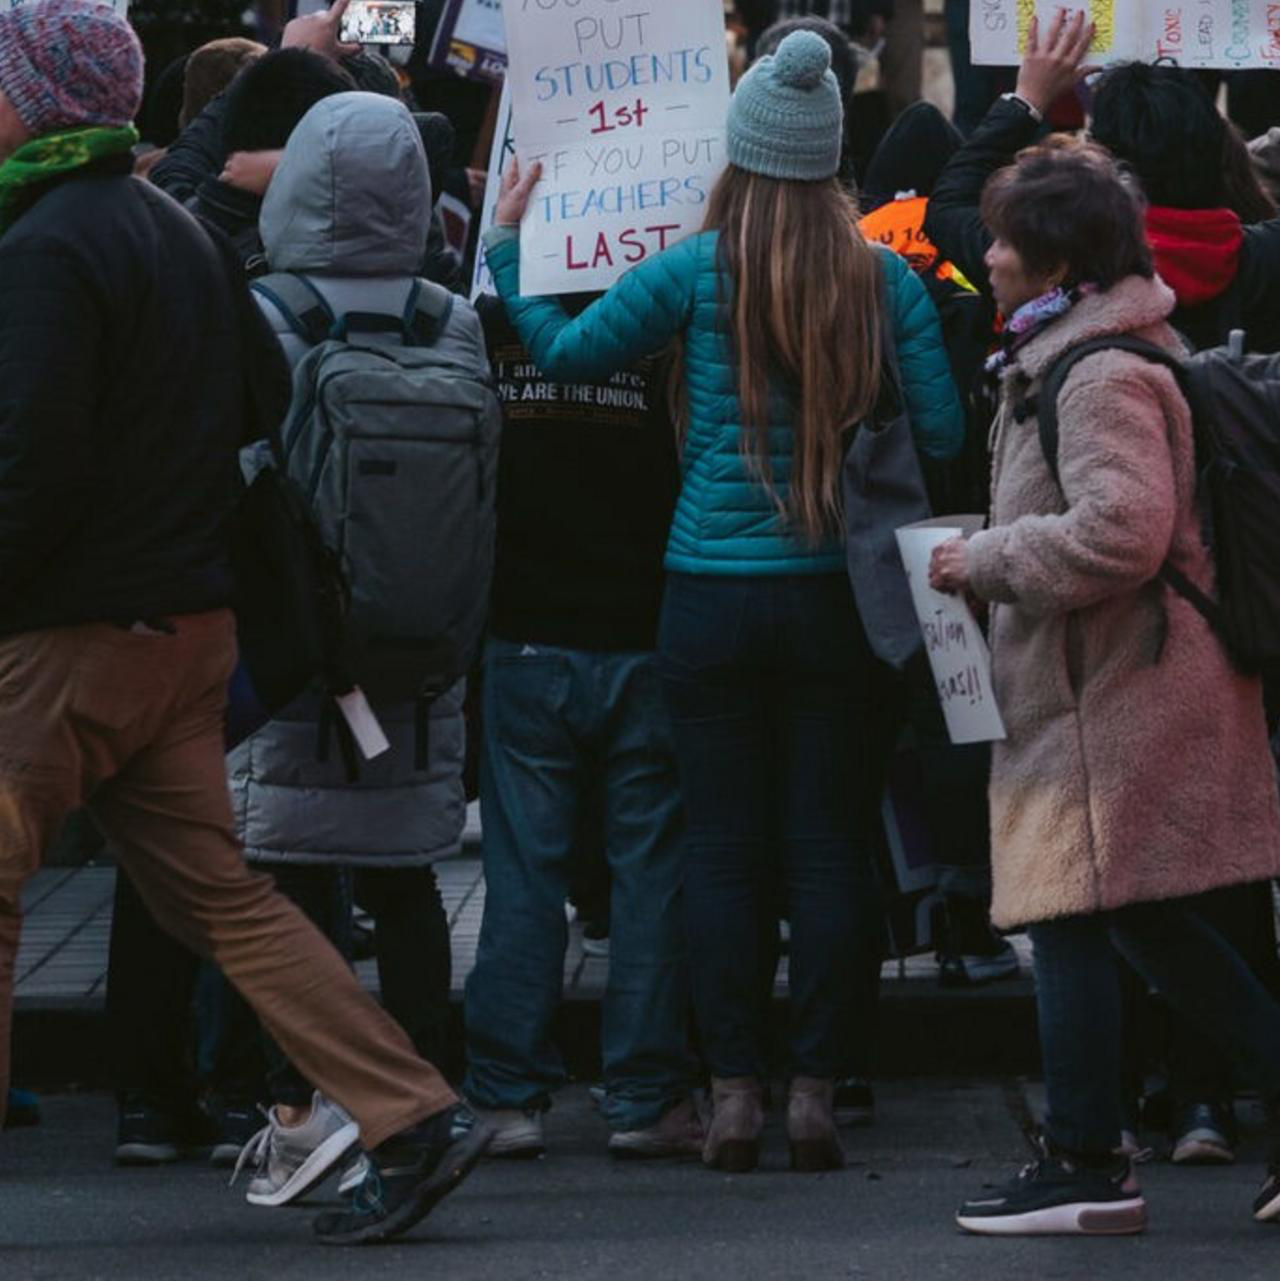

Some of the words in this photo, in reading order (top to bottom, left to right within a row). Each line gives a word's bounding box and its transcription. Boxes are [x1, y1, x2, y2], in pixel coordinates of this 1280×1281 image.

[575, 12, 651, 54] PUT
[535, 47, 712, 102] STUDENTS
[588, 98, 649, 135] 1st
[584, 147, 644, 175] YOU
[662, 137, 719, 168] PUT
[539, 175, 706, 224] TEACHERS
[566, 224, 682, 270] LAST
[521, 381, 559, 401] ARE
[561, 384, 596, 404] THE
[596, 384, 649, 411] UNION.
